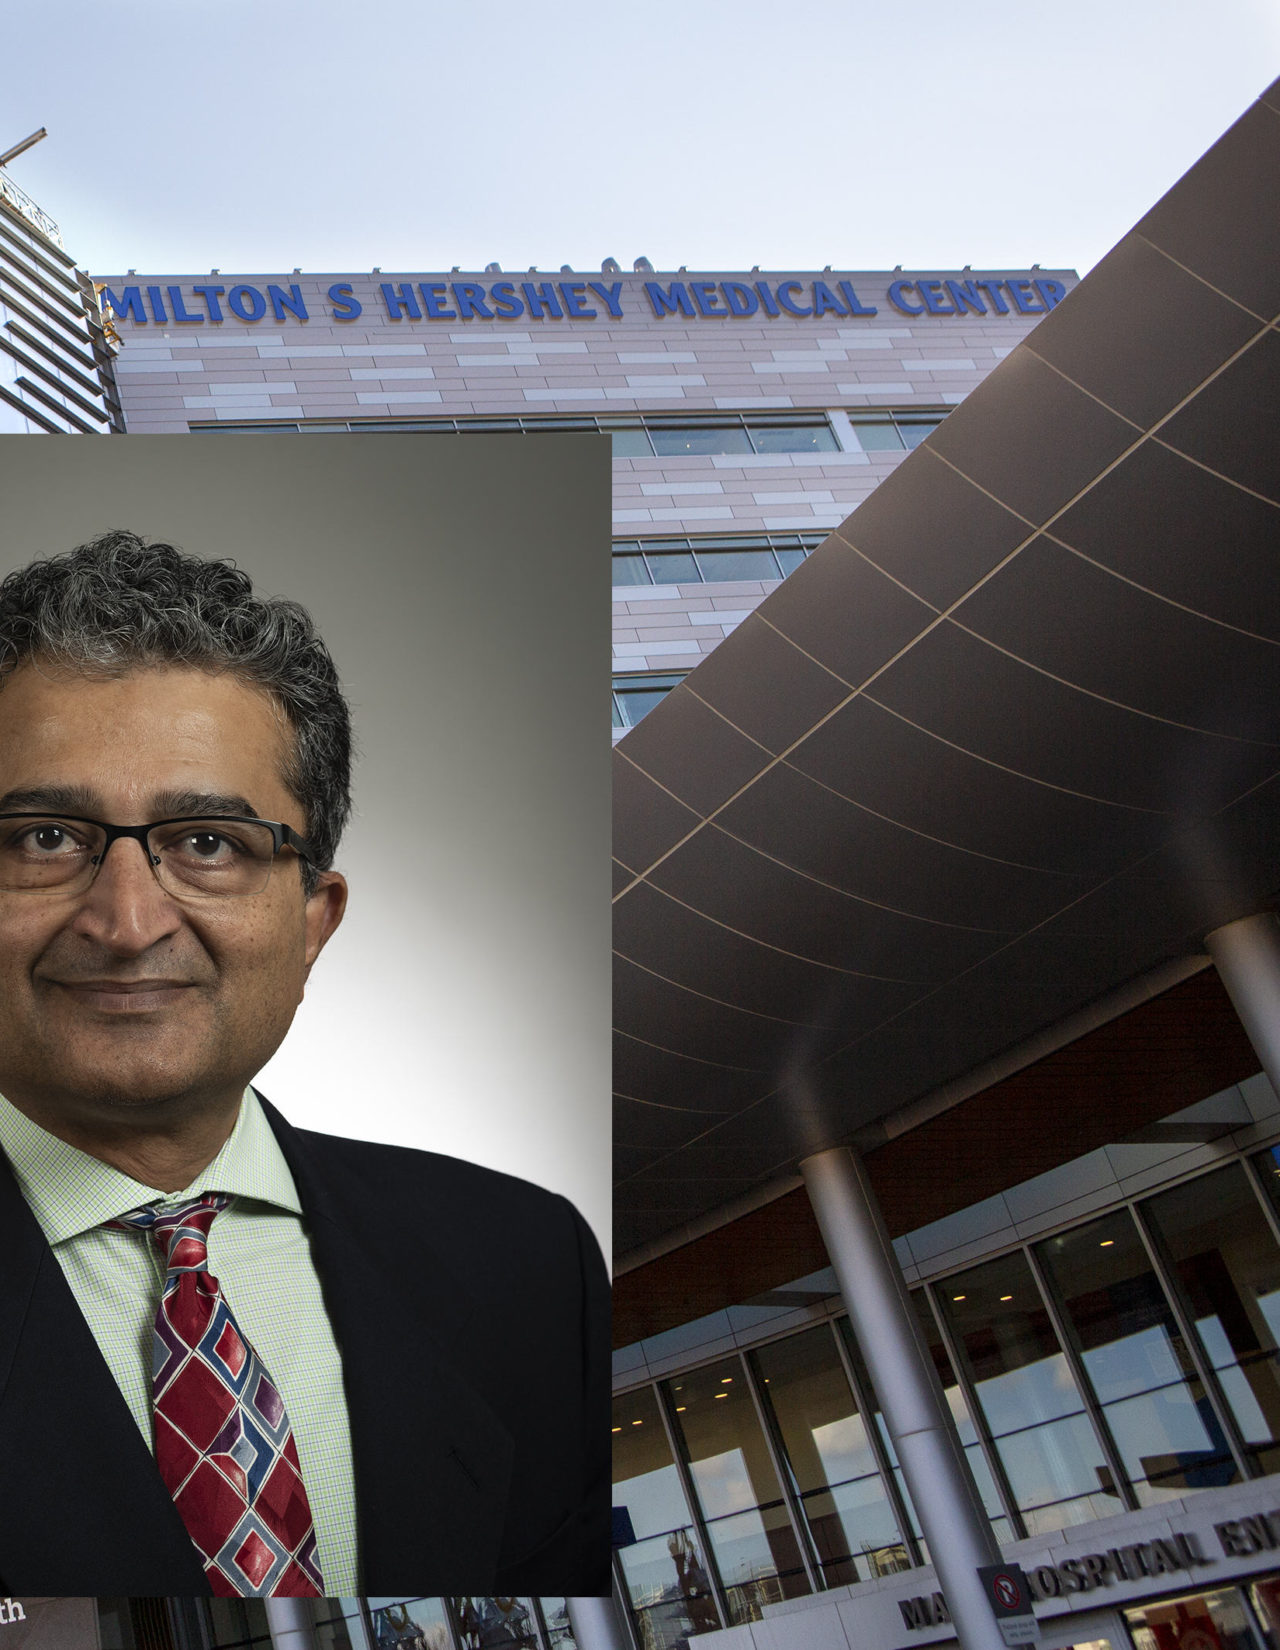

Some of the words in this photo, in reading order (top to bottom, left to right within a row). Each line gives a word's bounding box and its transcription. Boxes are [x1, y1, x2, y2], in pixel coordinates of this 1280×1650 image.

[100, 284, 309, 323] MILTON
[327, 283, 362, 320] S
[380, 281, 624, 320] HERSHEY
[644, 279, 878, 318] MEDICAL
[888, 279, 1067, 316] CENTER
[1026, 1533, 1215, 1601] OSPITAL
